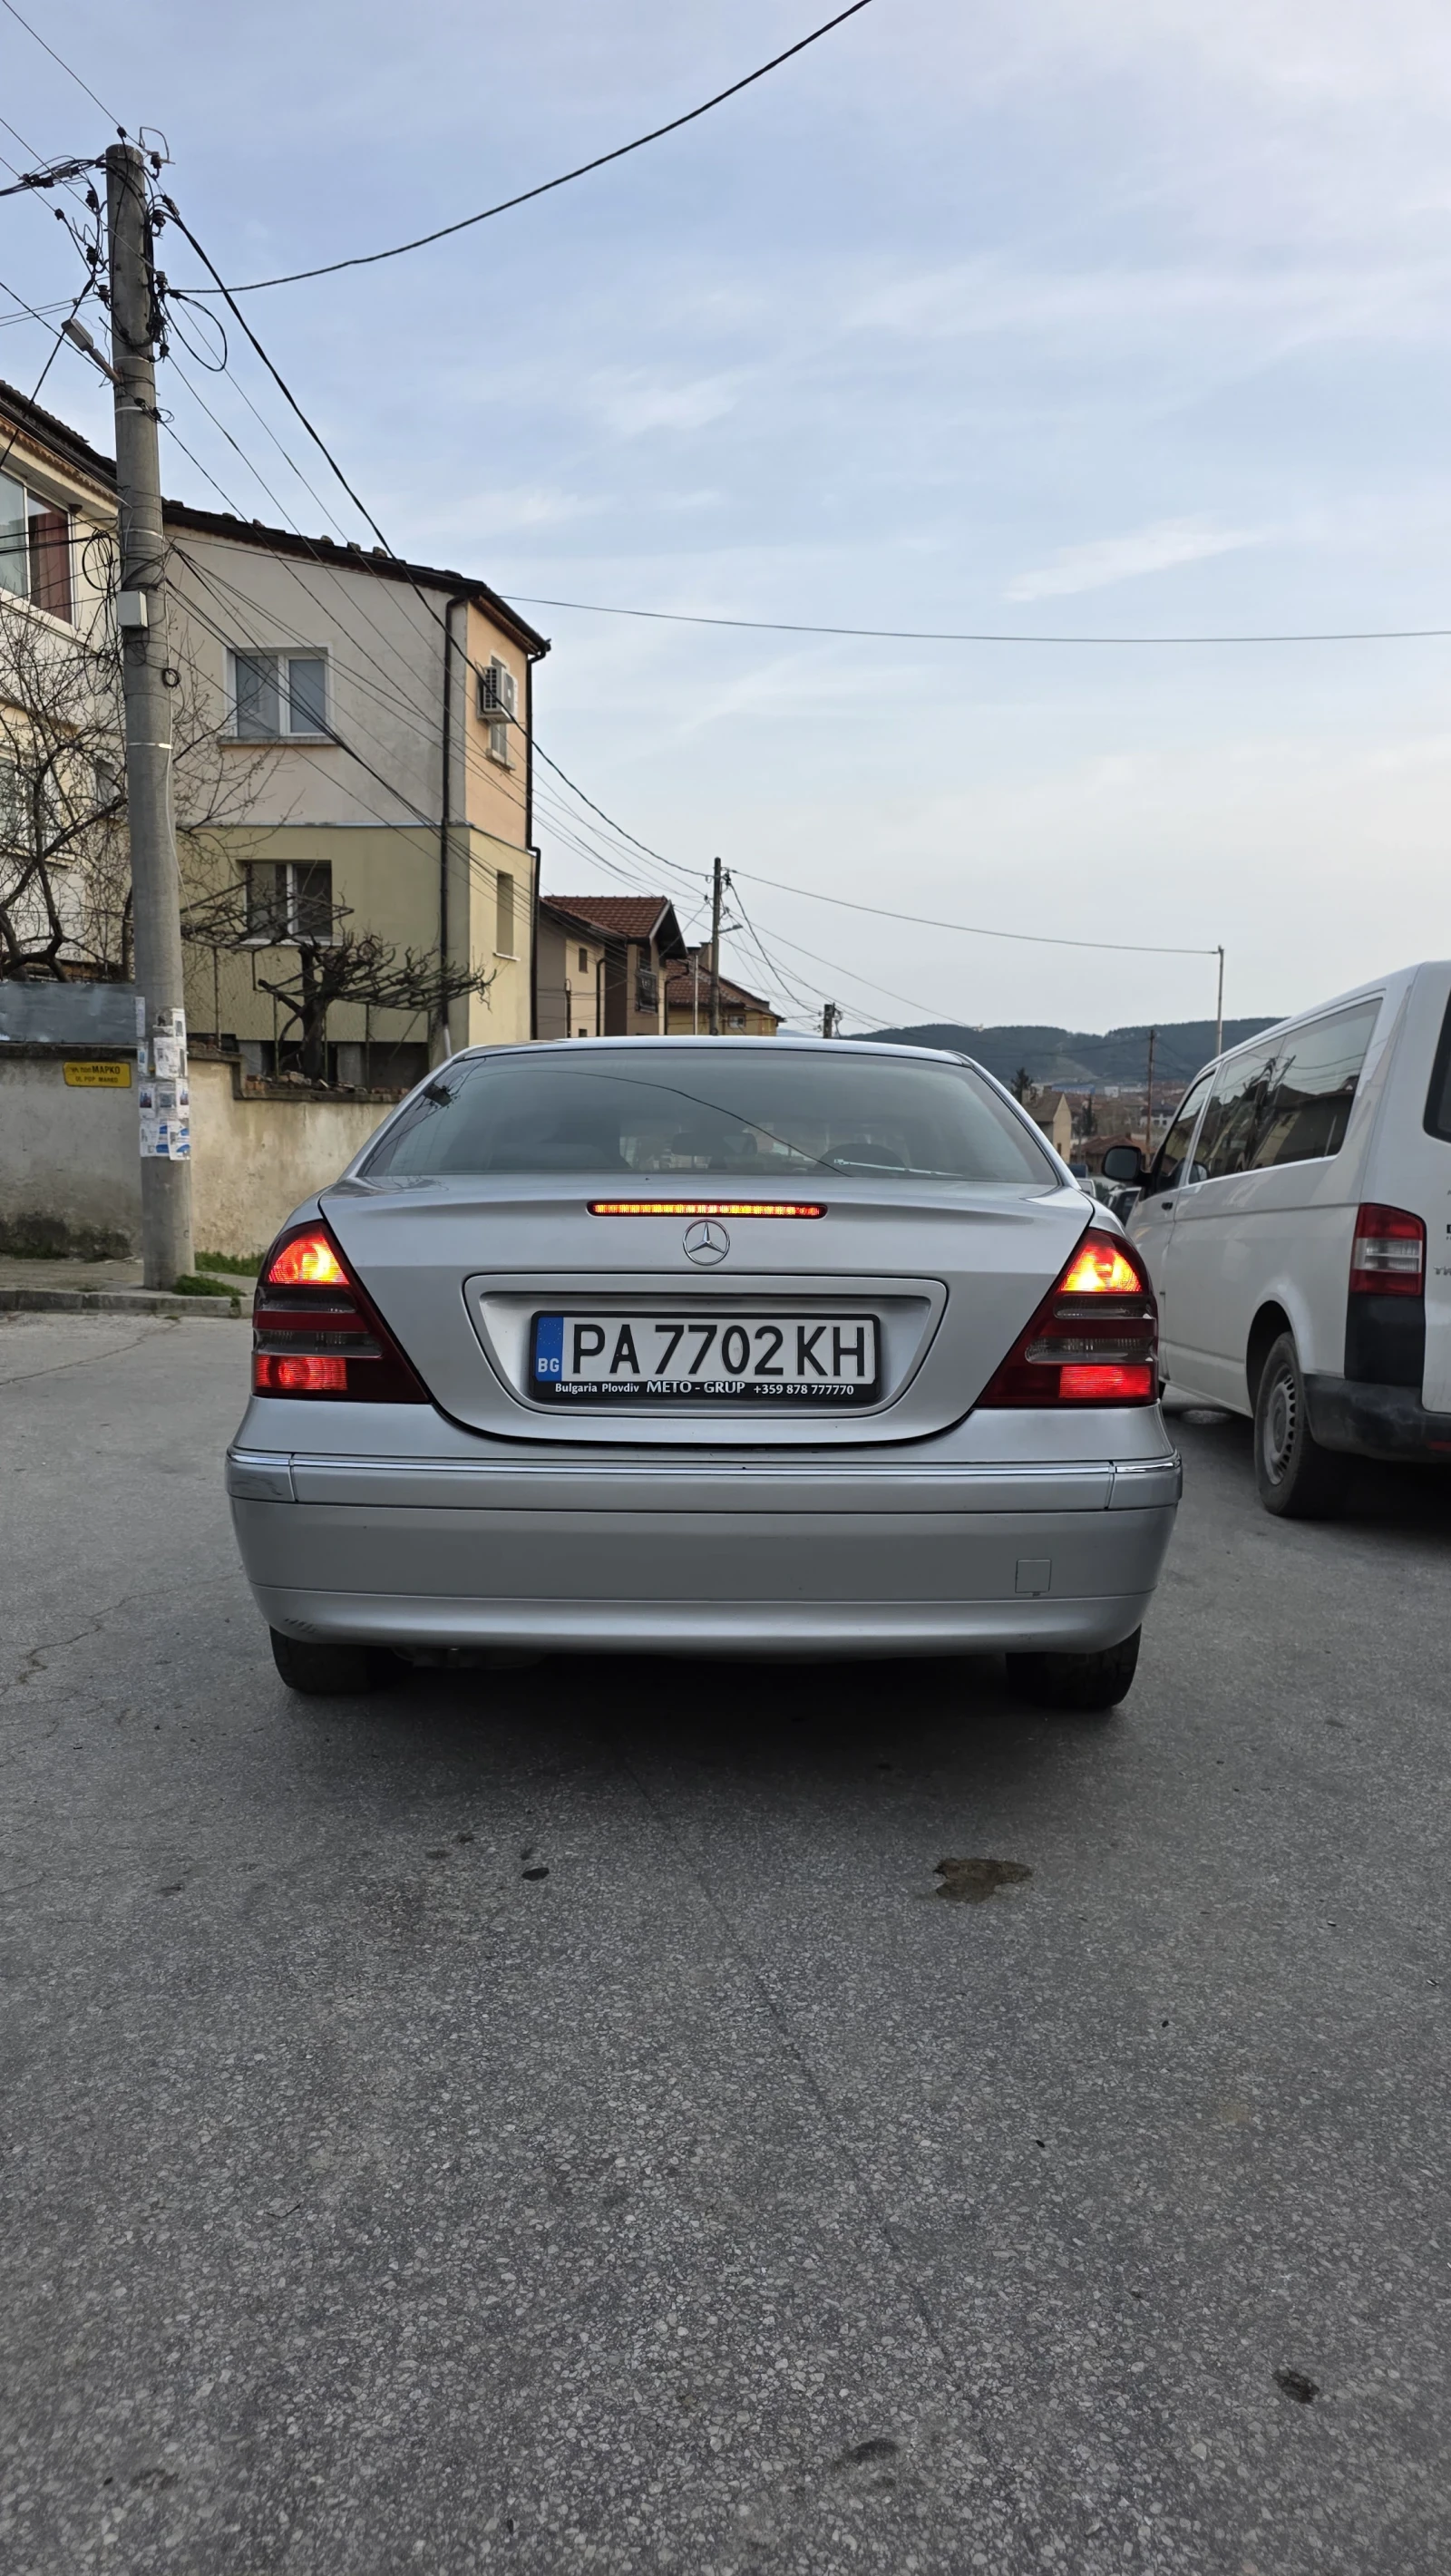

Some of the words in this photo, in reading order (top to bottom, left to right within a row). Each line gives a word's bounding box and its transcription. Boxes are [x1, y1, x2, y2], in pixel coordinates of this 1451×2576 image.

[93, 1065, 121, 1074] МАРКО
[572, 1324, 640, 1375] PA
[655, 1325, 784, 1375] 7702
[796, 1326, 865, 1376] KH
[538, 1357, 560, 1373] BG
[555, 1383, 598, 1395] Bulgaria
[601, 1383, 639, 1393] Plovdiv
[647, 1381, 692, 1393] METO
[704, 1381, 745, 1394] GRUP
[754, 1385, 784, 1395] +359
[786, 1385, 808, 1395] 878
[811, 1385, 854, 1395] 777770
